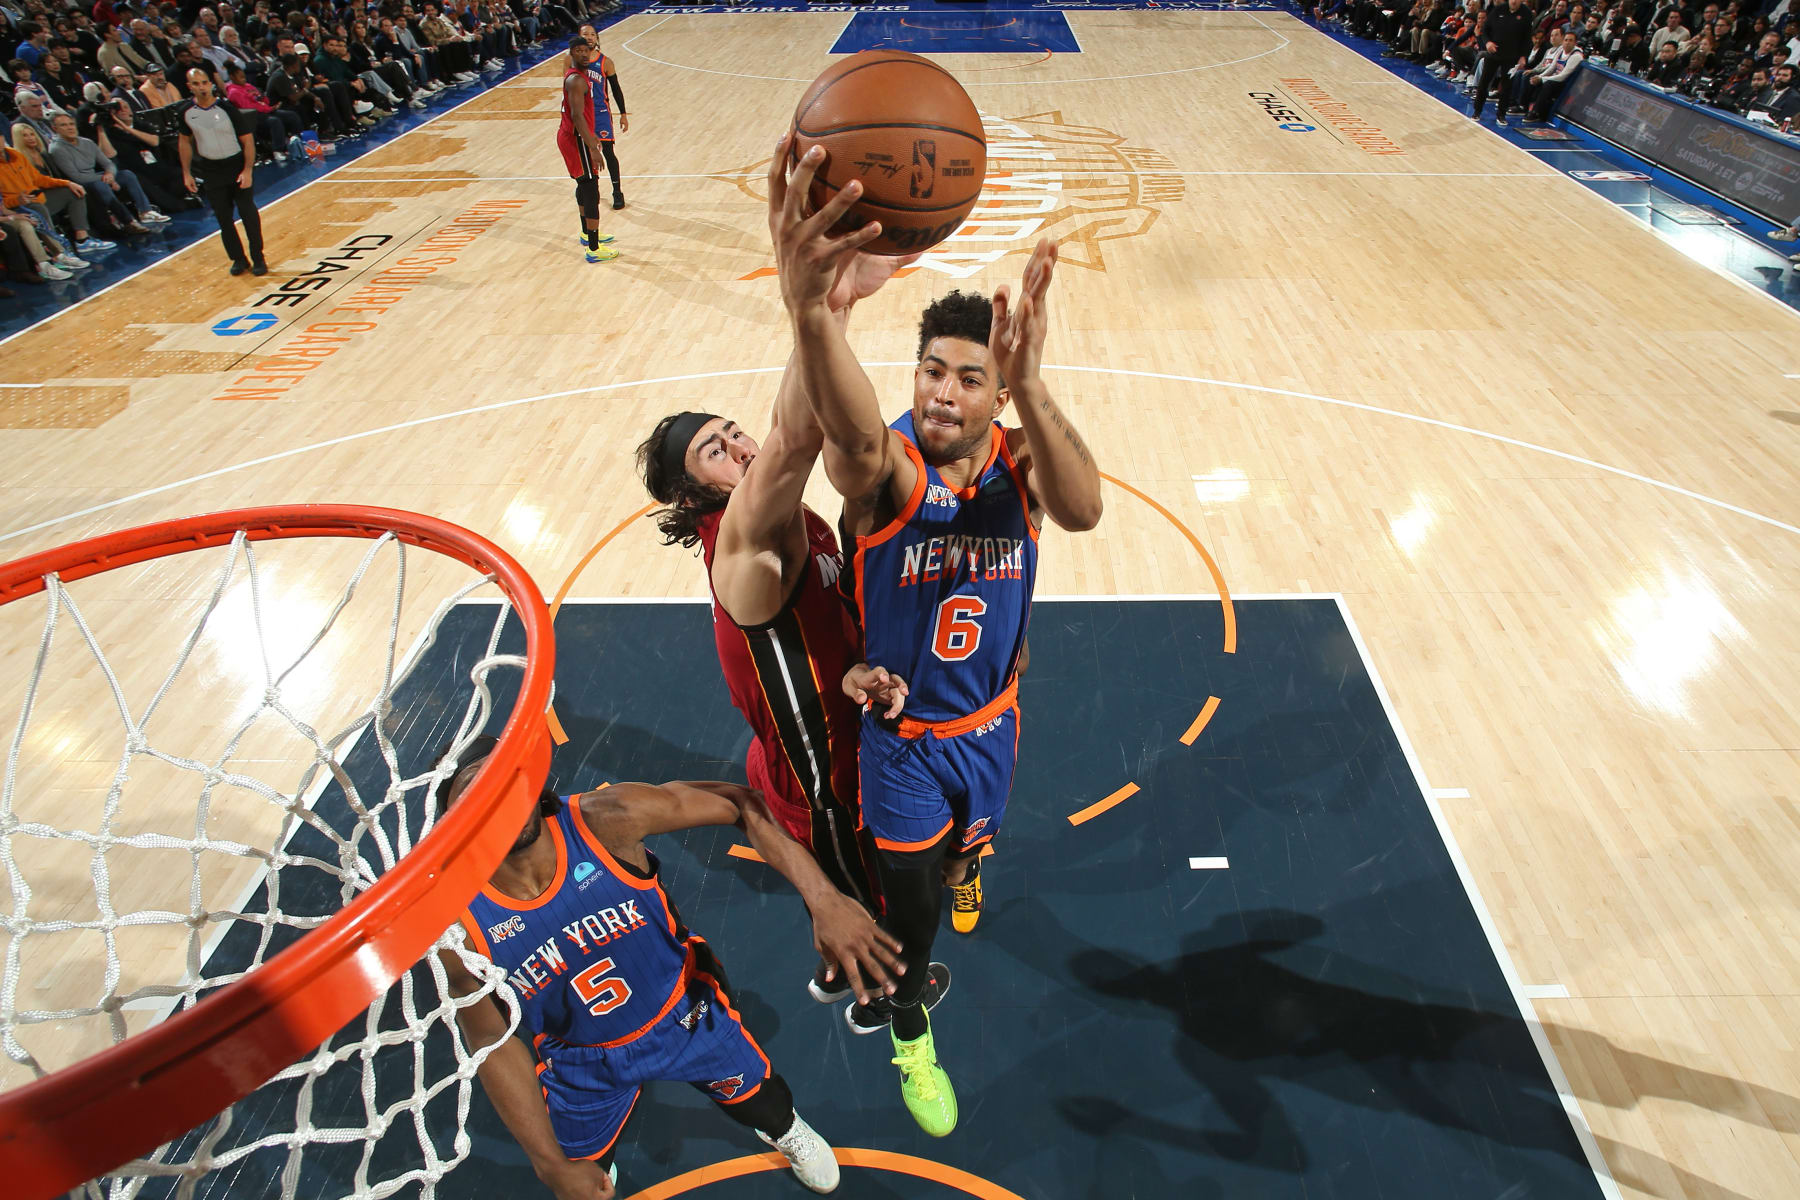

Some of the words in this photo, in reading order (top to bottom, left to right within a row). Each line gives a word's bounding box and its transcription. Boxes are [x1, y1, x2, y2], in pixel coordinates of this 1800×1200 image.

[1248, 92, 1304, 122] CHASE
[1307, 102, 1369, 126] SQUARE
[1339, 127, 1409, 156] GARDEN
[412, 199, 530, 252] MADISON
[251, 234, 393, 307] CHASE
[327, 256, 458, 315] SQUARE
[212, 321, 378, 400] GARDEN
[925, 483, 958, 508] NYC
[899, 534, 965, 587] NEW
[967, 536, 1024, 583] YORK
[931, 594, 988, 662] 6
[578, 869, 604, 892] sphere
[488, 915, 526, 944] NYC
[508, 936, 568, 999] NEW
[562, 899, 647, 954] YORK
[570, 956, 633, 1017] 5
